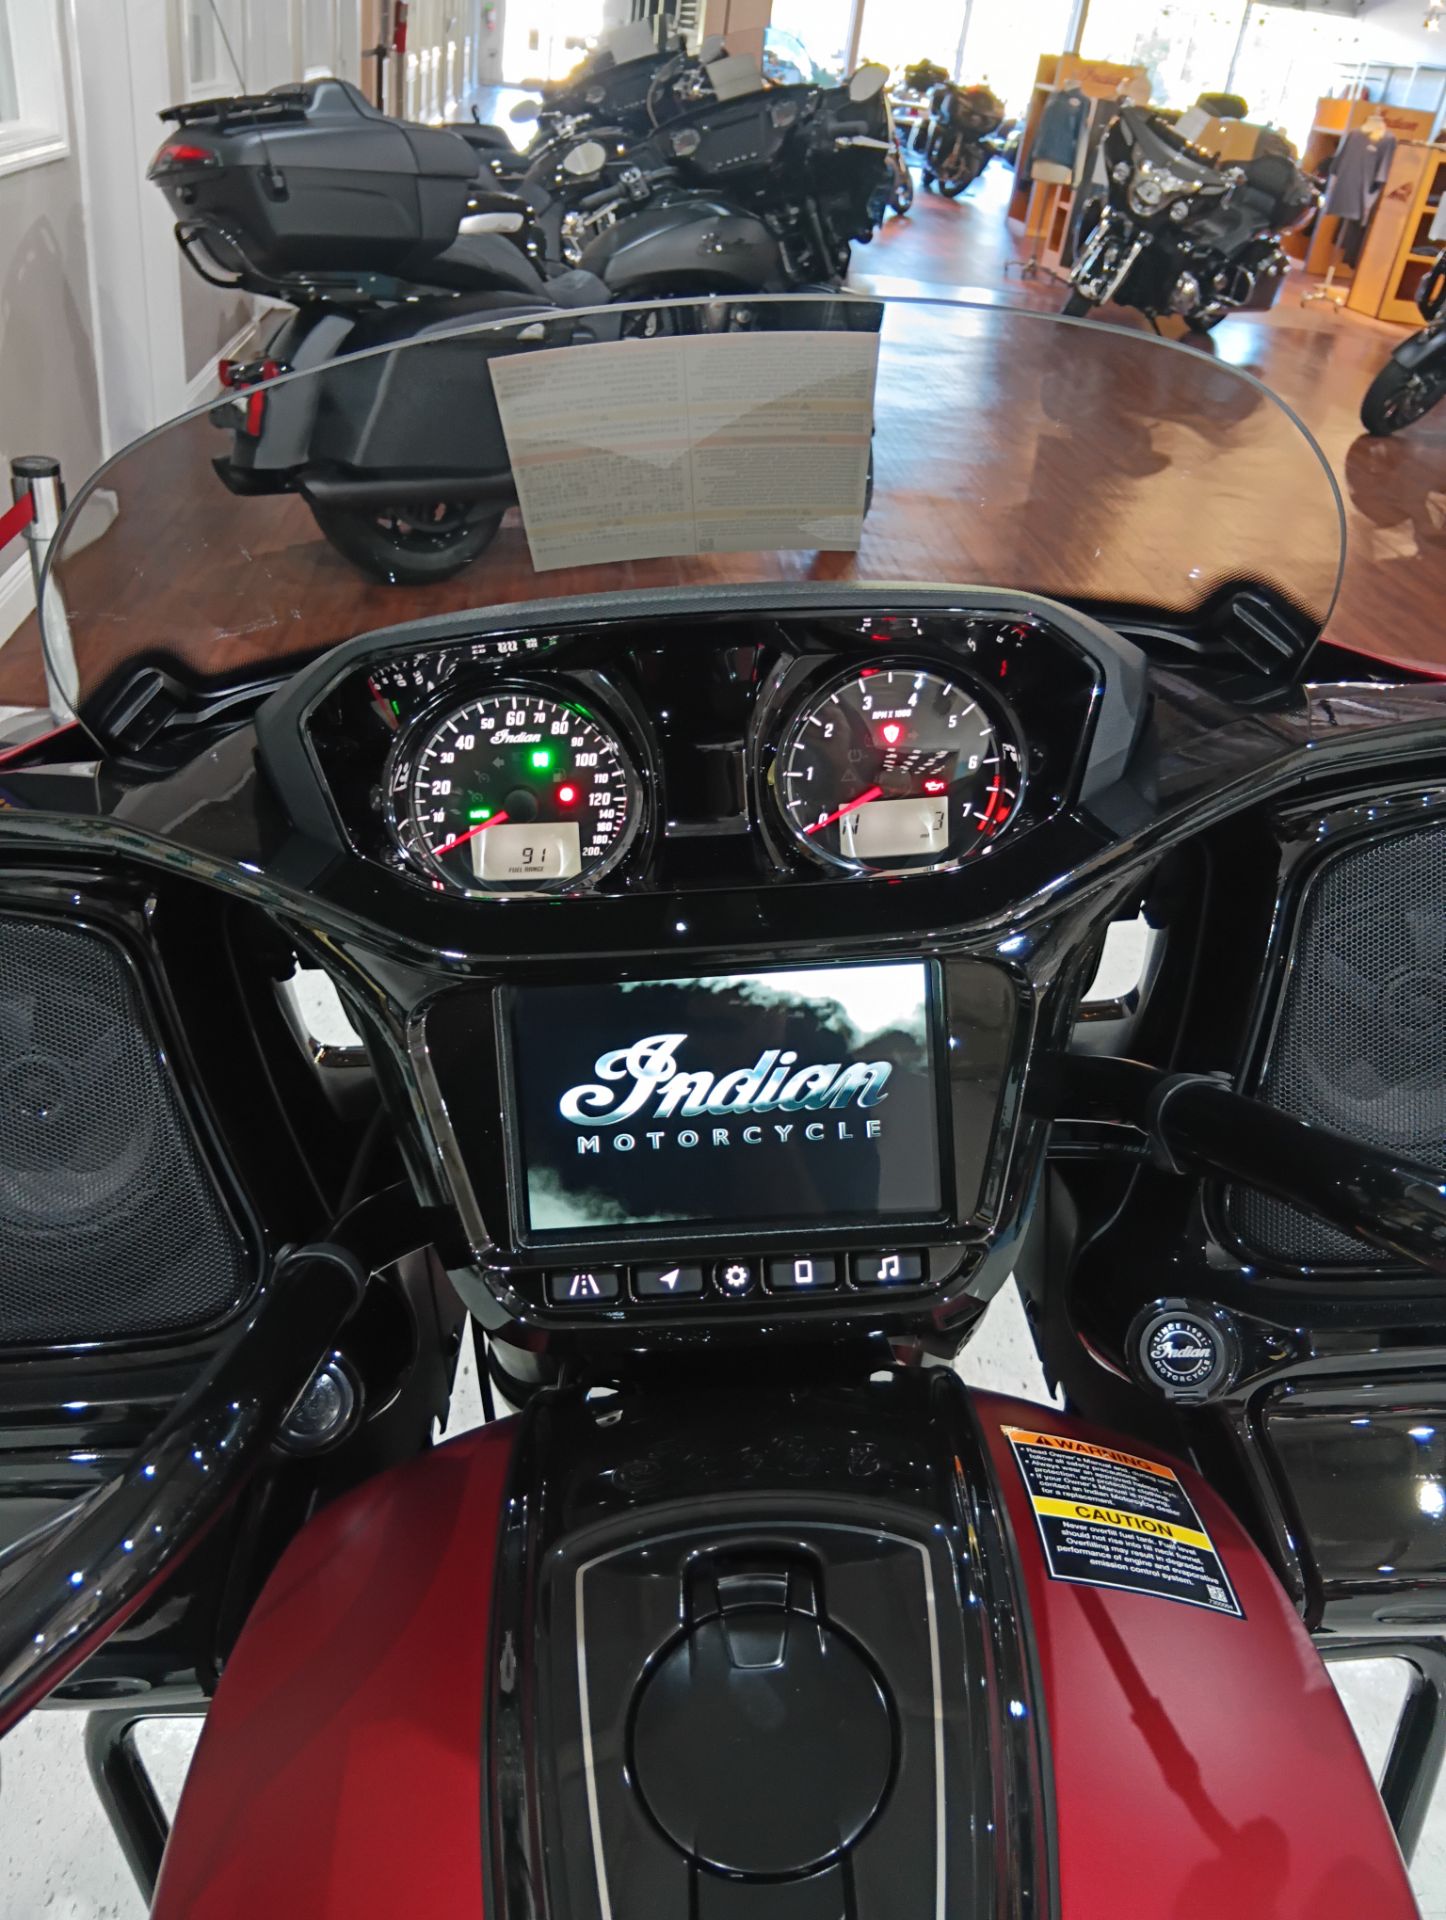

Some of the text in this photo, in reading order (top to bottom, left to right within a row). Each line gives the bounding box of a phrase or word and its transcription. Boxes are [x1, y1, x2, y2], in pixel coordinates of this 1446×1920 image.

[863, 695, 873, 710] 3
[908, 692, 918, 707] 4
[506, 711, 526, 727] 60
[533, 712, 546, 724] 70
[872, 710, 888, 720] RPM
[948, 715, 957, 729] 5
[480, 718, 495, 730] 50
[551, 721, 569, 736] 80
[824, 724, 834, 738] 2
[455, 735, 475, 750] 40
[490, 729, 542, 744] Indian
[571, 737, 584, 748] 90
[440, 752, 454, 764] 30
[575, 753, 598, 768] 100
[968, 755, 978, 770] 6
[594, 773, 609, 784] 110
[806, 766, 814, 781] 1
[431, 780, 451, 795] 20
[588, 792, 611, 806] 120
[433, 811, 445, 822] 10
[599, 809, 615, 819] 140
[962, 802, 972, 817] 7
[522, 847, 546, 865] 91
[582, 847, 600, 856] 200
[559, 1033, 893, 1126] Indian
[577, 1120, 882, 1154] MOTORCYCLE
[1154, 1322, 1181, 1342] SINCE
[1151, 1341, 1211, 1359] Indian
[1154, 1359, 1211, 1382] MOTORCYCLE
[1055, 1438, 1152, 1470] WARNING
[1083, 1488, 1110, 1497] Indian
[1062, 1520, 1088, 1531] Never
[1090, 1527, 1118, 1536] overfill
[1075, 1505, 1173, 1536] CAUTION
[1061, 1529, 1091, 1539] should
[1065, 1536, 1110, 1552] Overfilling
[1130, 1549, 1155, 1559] result
[1164, 1556, 1206, 1573] degraded
[1056, 1545, 1112, 1559] performance
[1124, 1556, 1154, 1567] engine
[1171, 1567, 1220, 1585] evaporative
[1089, 1558, 1129, 1570] emission
[1129, 1565, 1161, 1577] control
